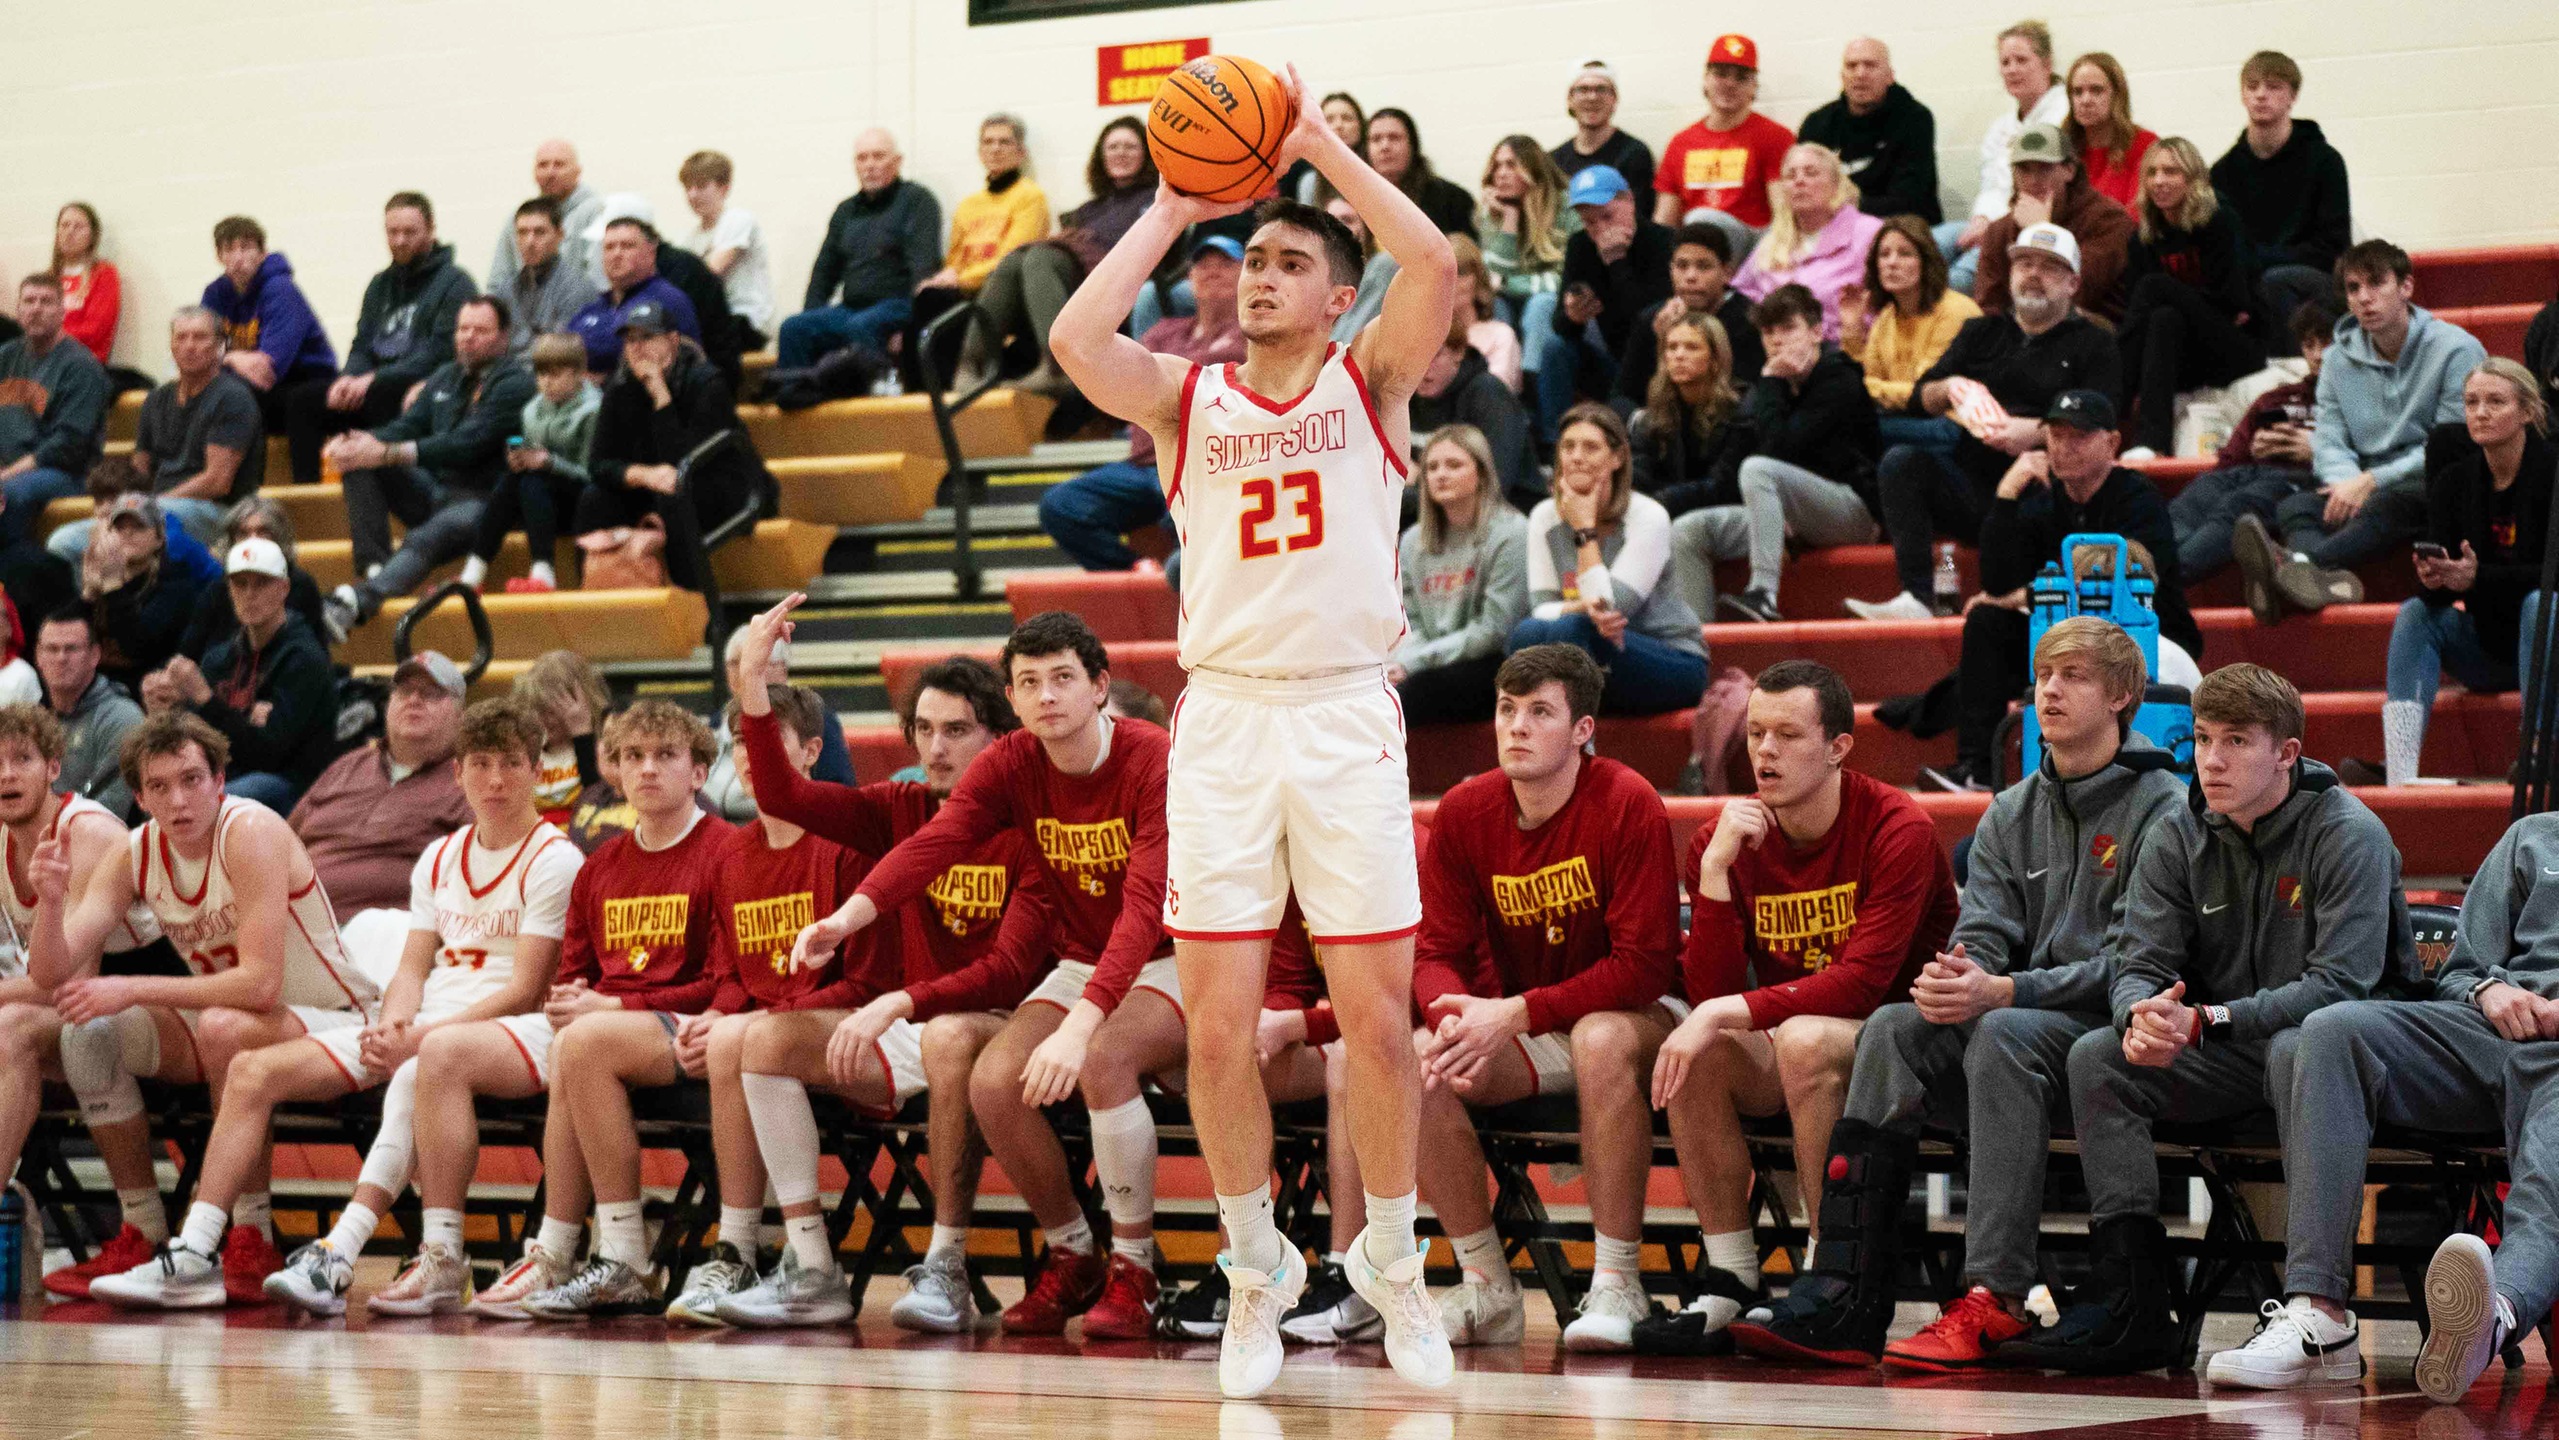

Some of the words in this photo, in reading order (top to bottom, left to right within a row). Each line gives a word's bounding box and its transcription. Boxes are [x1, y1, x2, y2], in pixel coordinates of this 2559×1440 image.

[1205, 409, 1346, 474] SIMPSON
[1239, 469, 1324, 560] 23
[1039, 824, 1129, 860] SIMPSON
[1494, 862, 1595, 915] SIMPSON
[606, 900, 687, 935] SIMPSON
[736, 898, 813, 939] SIMPSON
[1758, 890, 1855, 934] SIMPSON
